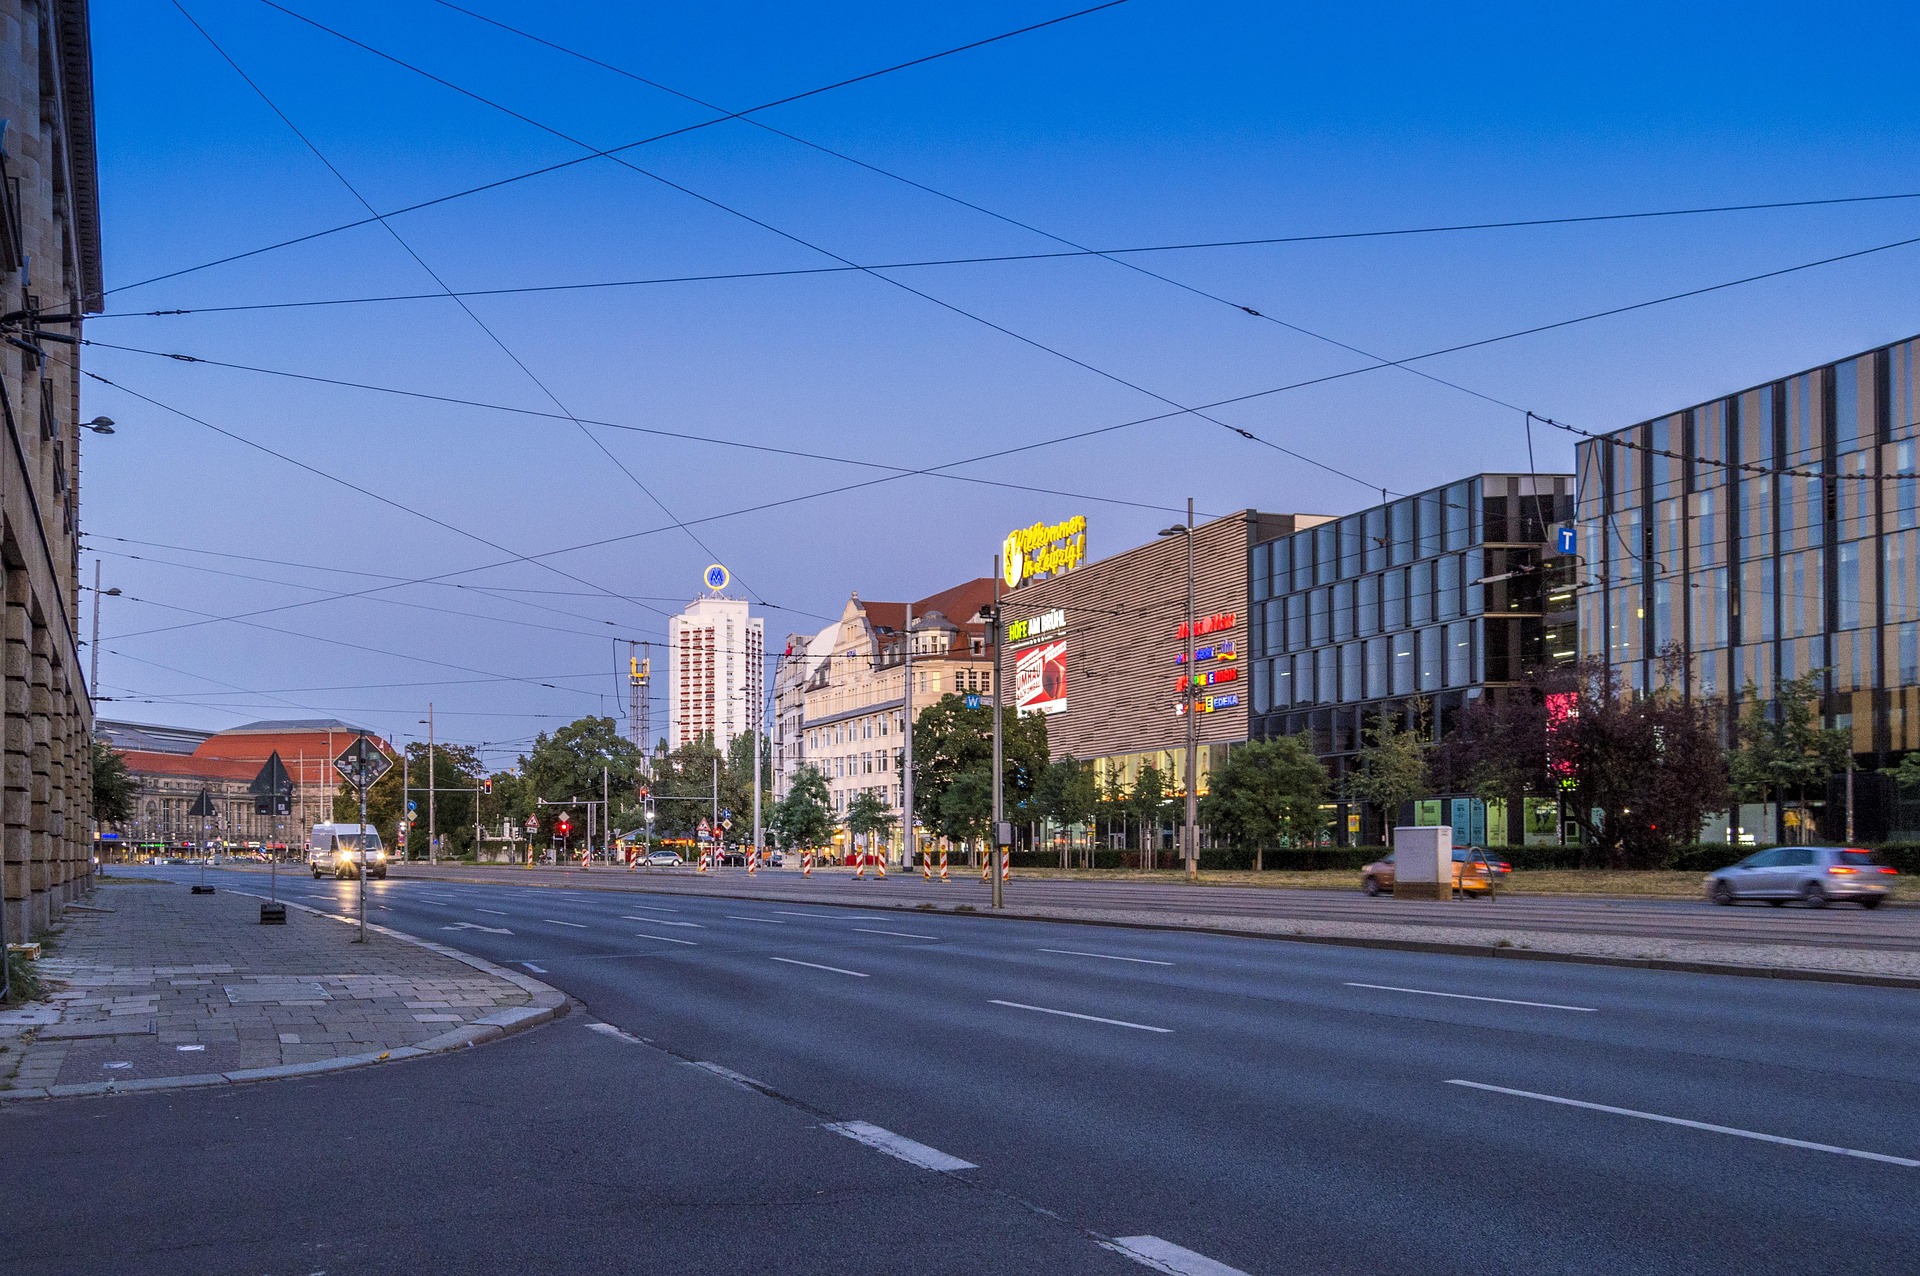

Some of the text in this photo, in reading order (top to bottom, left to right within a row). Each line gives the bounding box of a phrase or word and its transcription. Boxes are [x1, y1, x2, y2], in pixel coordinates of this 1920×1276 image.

[1562, 531, 1573, 550] T
[1009, 608, 1067, 641] HÖFE AM BRÜHL
[967, 696, 979, 707] W
[1214, 695, 1239, 709] EDEKA
